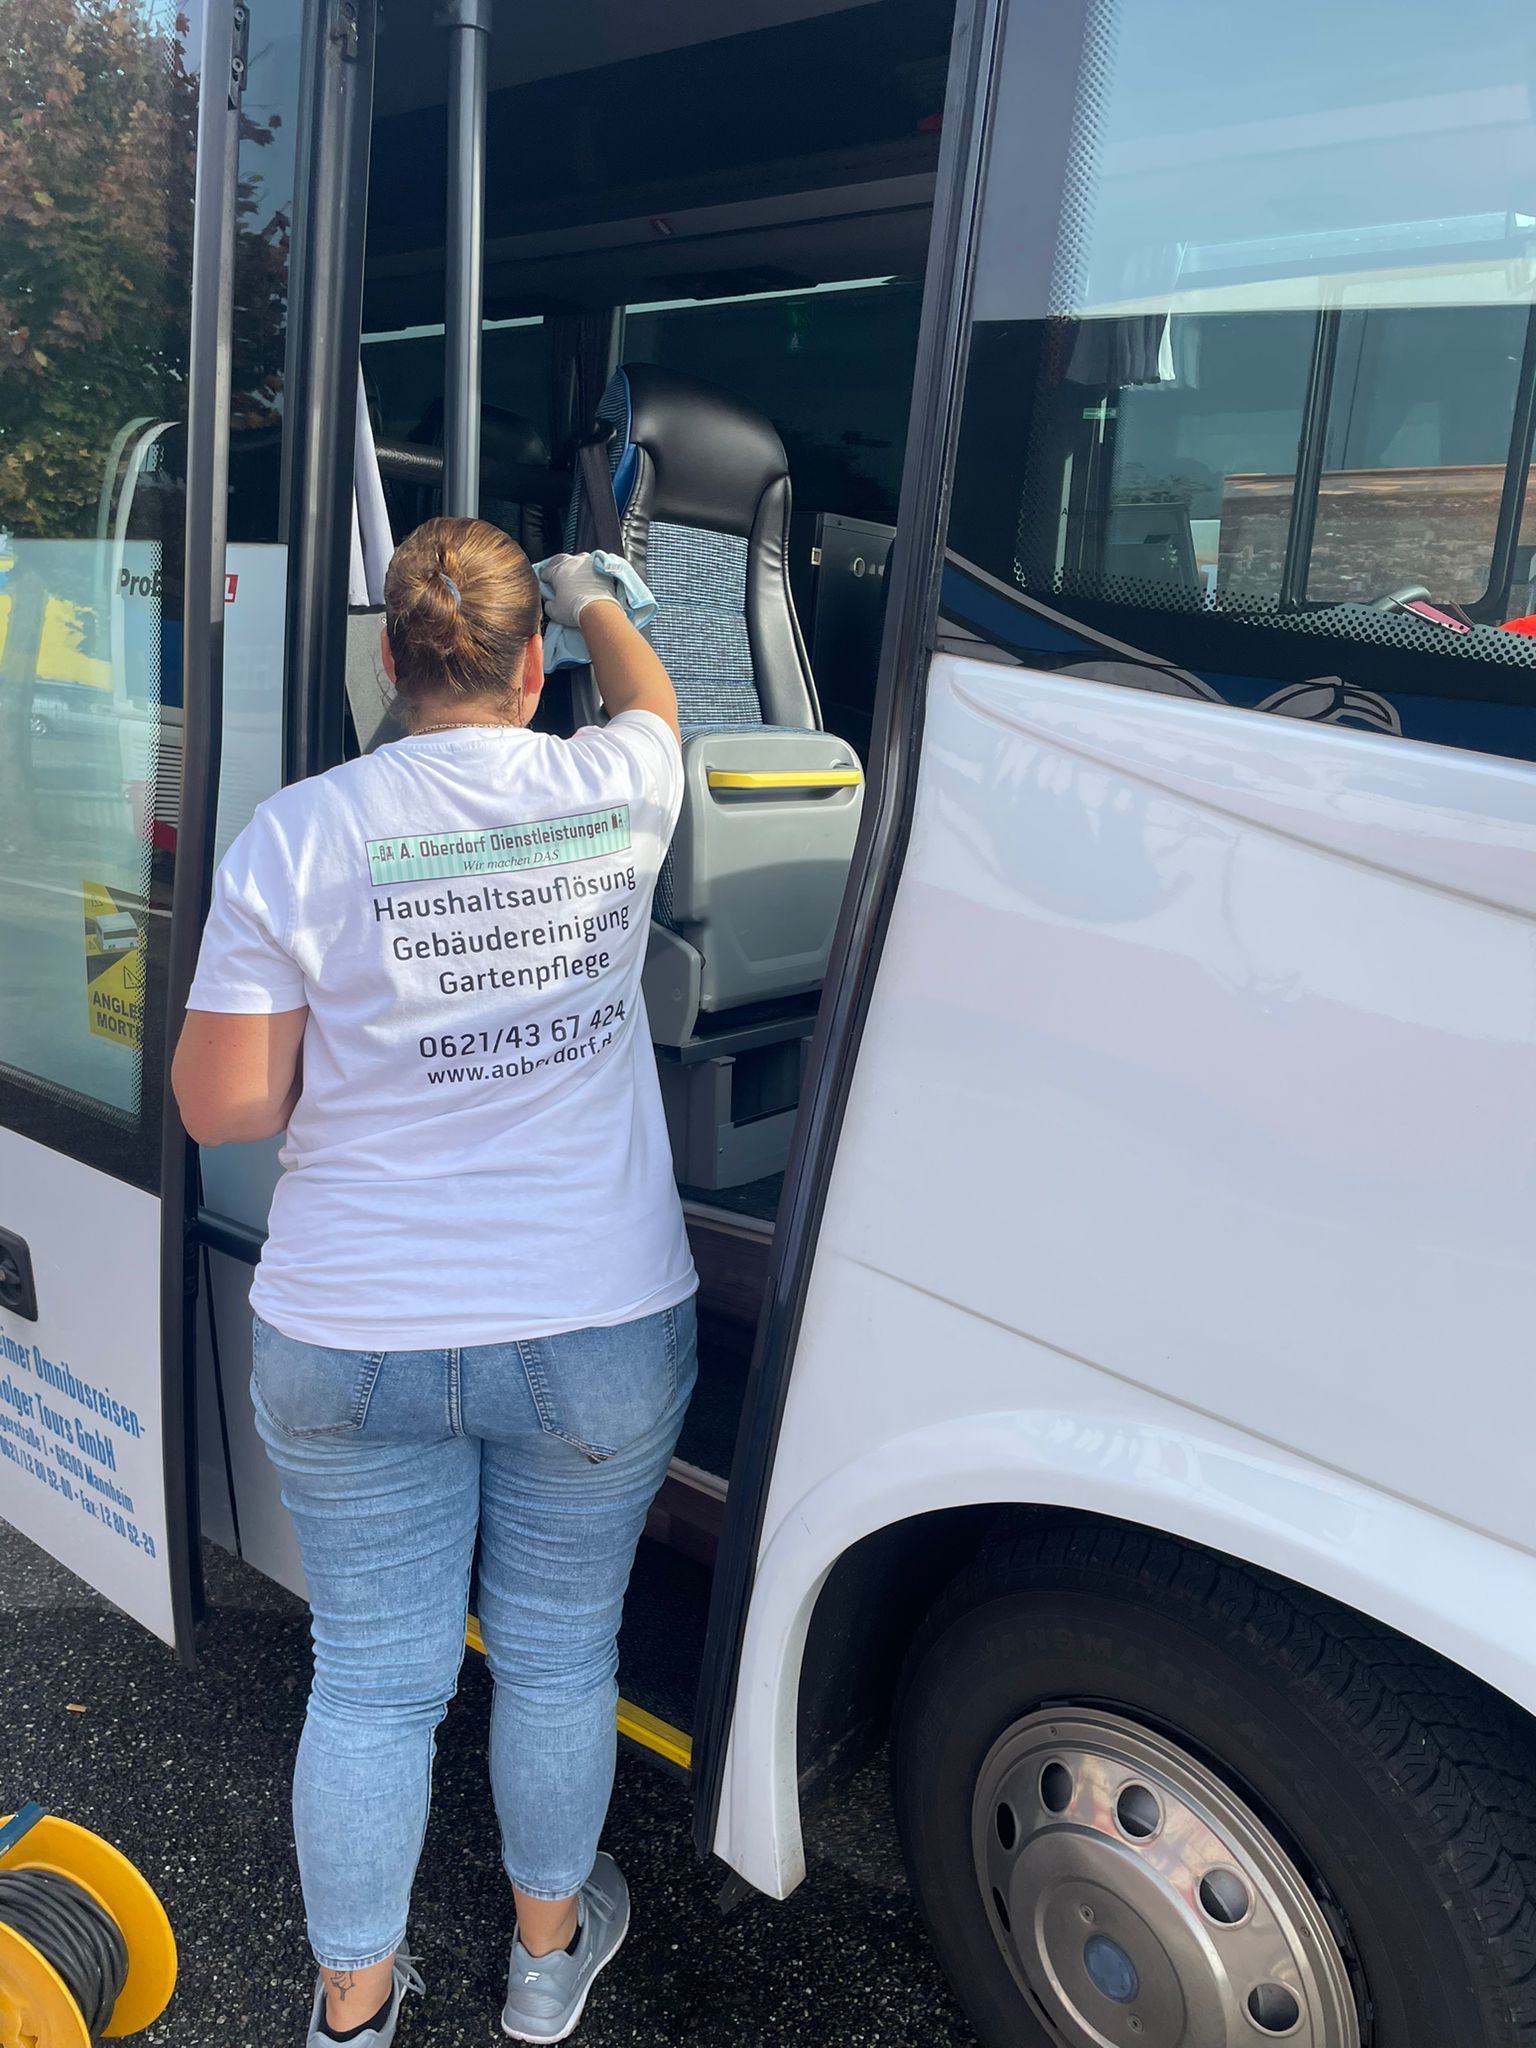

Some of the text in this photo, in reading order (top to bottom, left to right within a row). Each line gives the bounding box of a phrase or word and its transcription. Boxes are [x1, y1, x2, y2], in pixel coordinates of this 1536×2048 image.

[400, 820, 609, 860] A. Oberdorf Dienstleistungen
[464, 848, 560, 871] Wir machen DAS
[373, 864, 636, 922] Haushaltsauflösung
[393, 905, 630, 961] Gebäudereinigung
[439, 950, 610, 994] Gartenpflege
[420, 999, 626, 1058] 0621/43 67 424
[32, 1344, 146, 1439] Omnibusreisen-
[34, 1392, 74, 1444] Tours
[74, 1417, 117, 1472] GmbH
[84, 1462, 135, 1514] Mannheim
[99, 1502, 113, 1529] 12
[112, 1511, 127, 1538] 80
